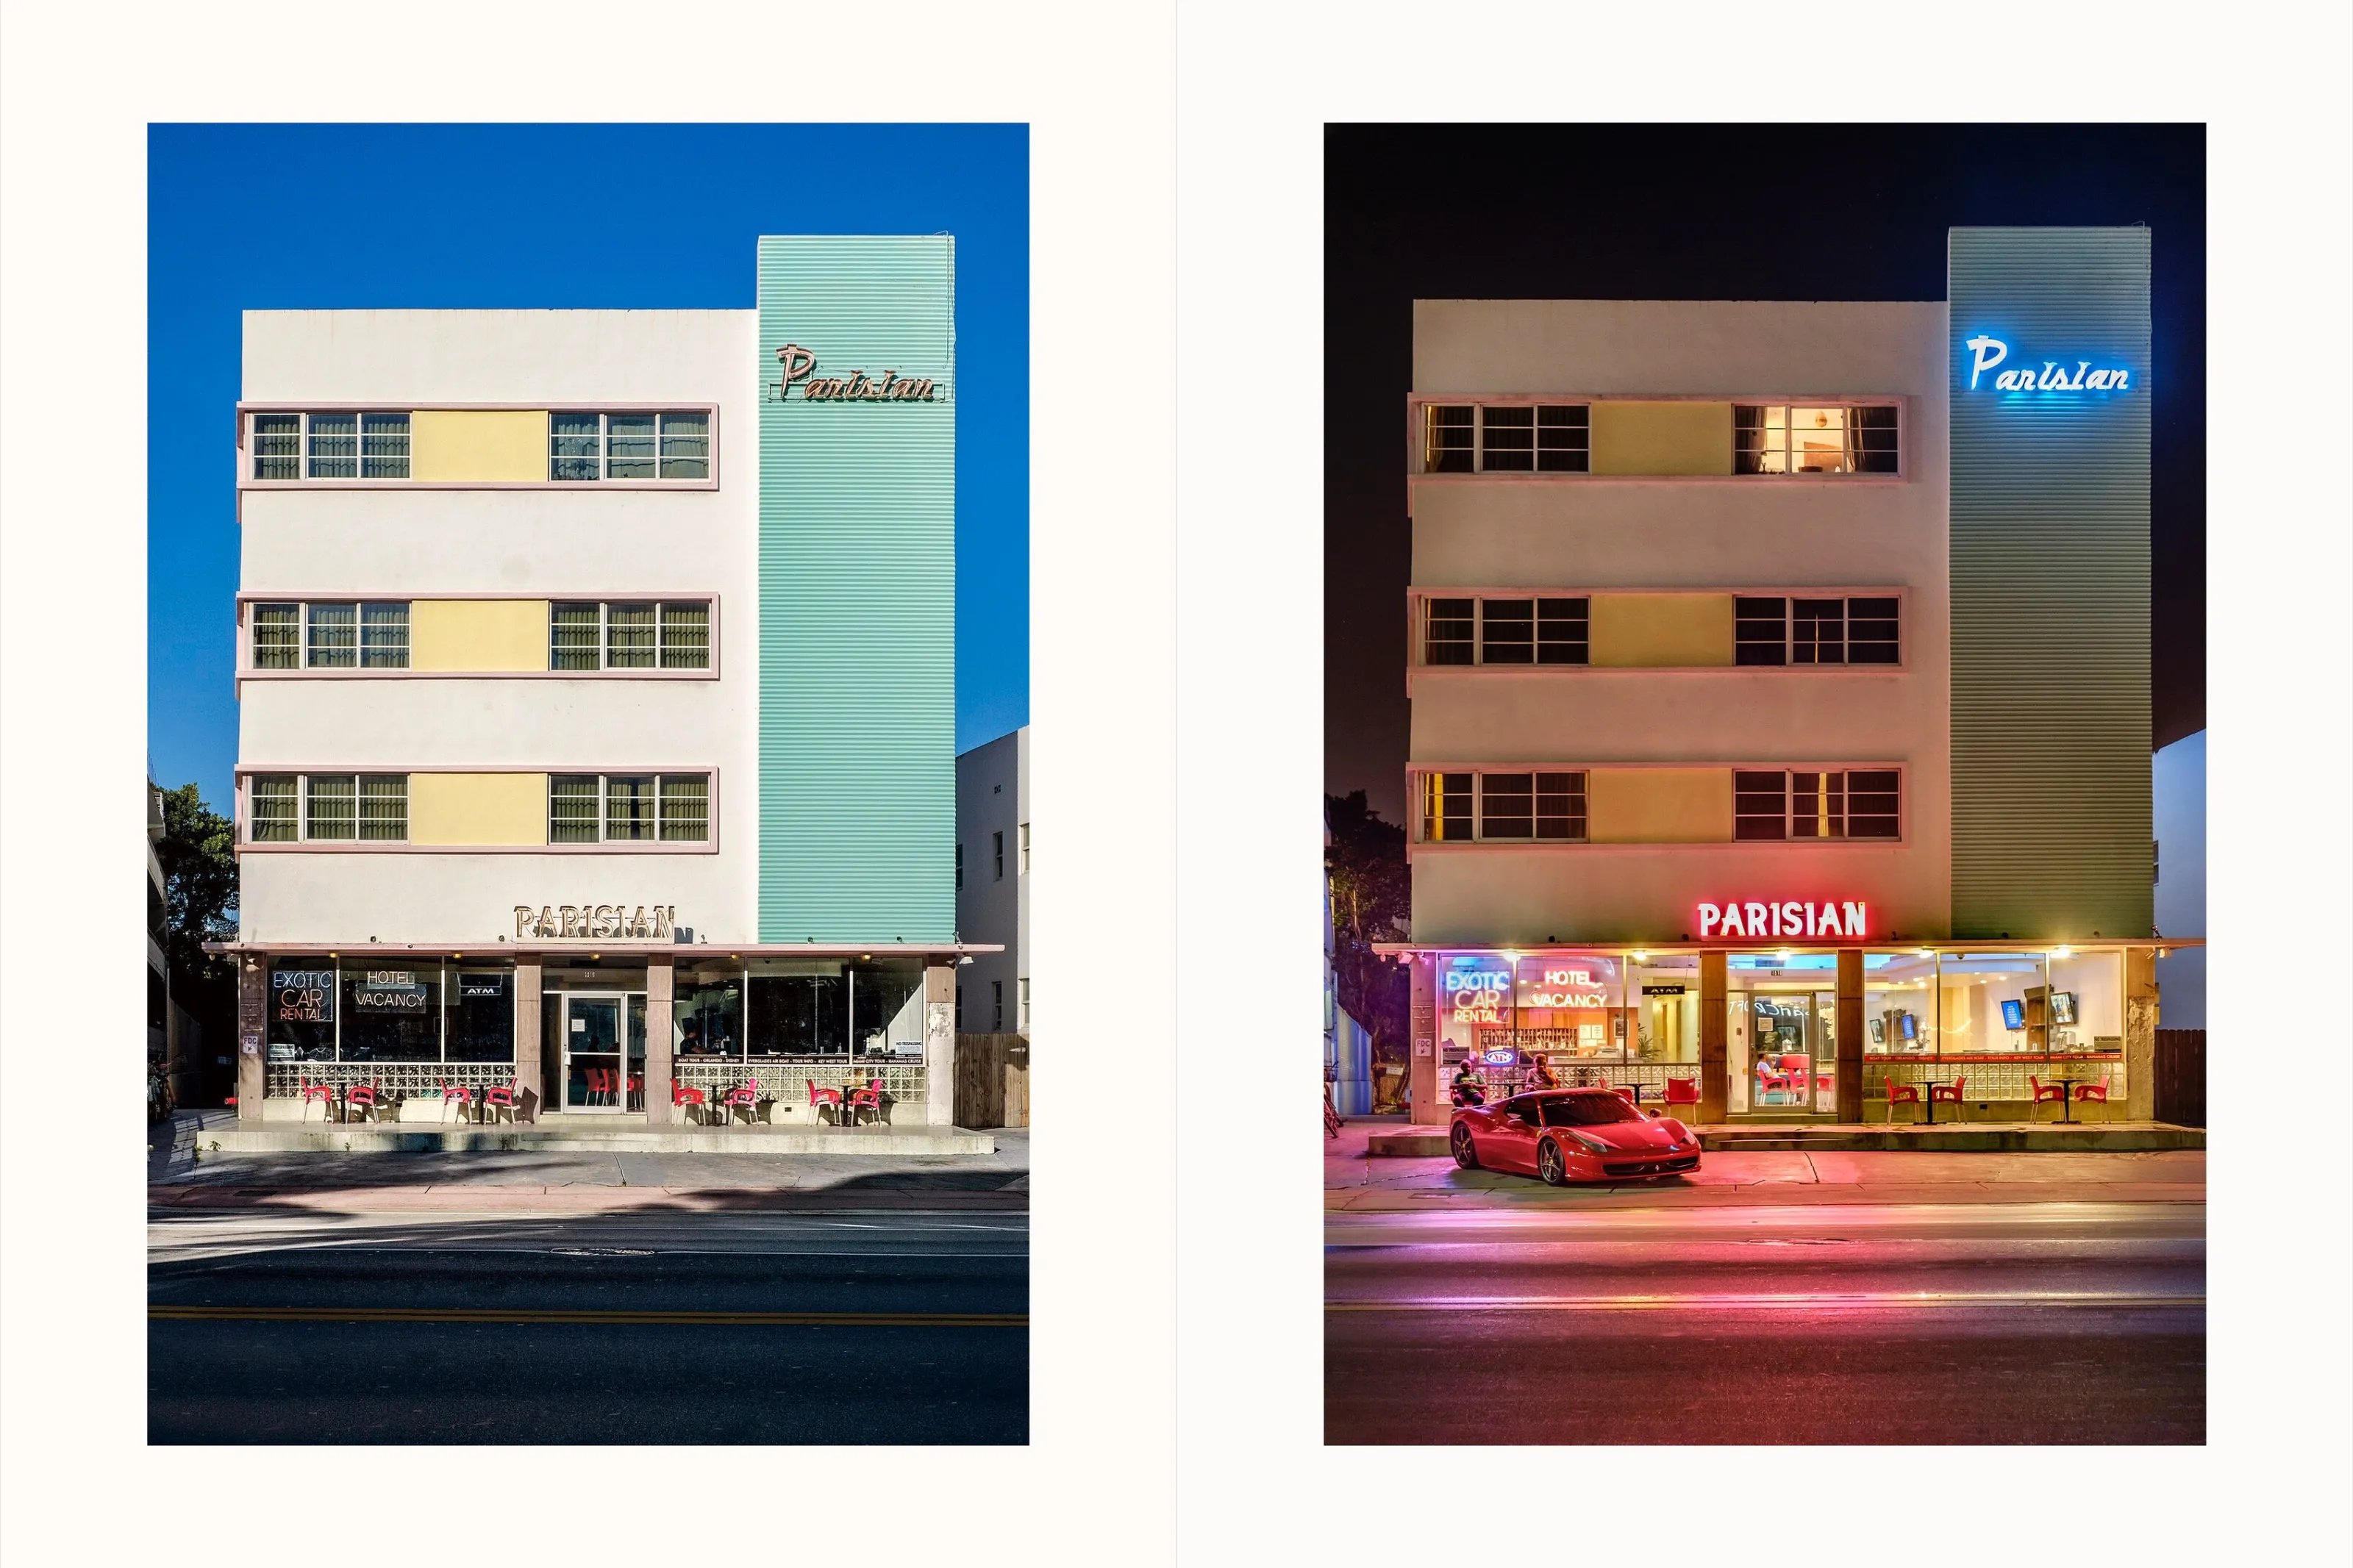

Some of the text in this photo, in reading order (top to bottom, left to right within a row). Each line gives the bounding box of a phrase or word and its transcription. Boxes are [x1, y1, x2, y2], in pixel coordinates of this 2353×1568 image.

[776, 343, 935, 399] Parisian
[1966, 335, 2129, 391] Parisian
[514, 905, 675, 938] PARISIAN
[1697, 901, 1865, 936] PARISIAN
[274, 972, 332, 988] EXOTIC
[368, 971, 414, 984] HOTEL
[1446, 973, 1510, 991] EXOTIC
[1545, 971, 1593, 986] HOTEL
[281, 989, 324, 1007] CAR
[356, 993, 426, 1007] VACANCY
[1455, 989, 1500, 1009] CAR
[1532, 993, 1607, 1008] VACANCY
[280, 1008, 326, 1020] RENTAL
[1454, 1009, 1502, 1023] RENTAL
[1417, 1039, 1431, 1048] FDC
